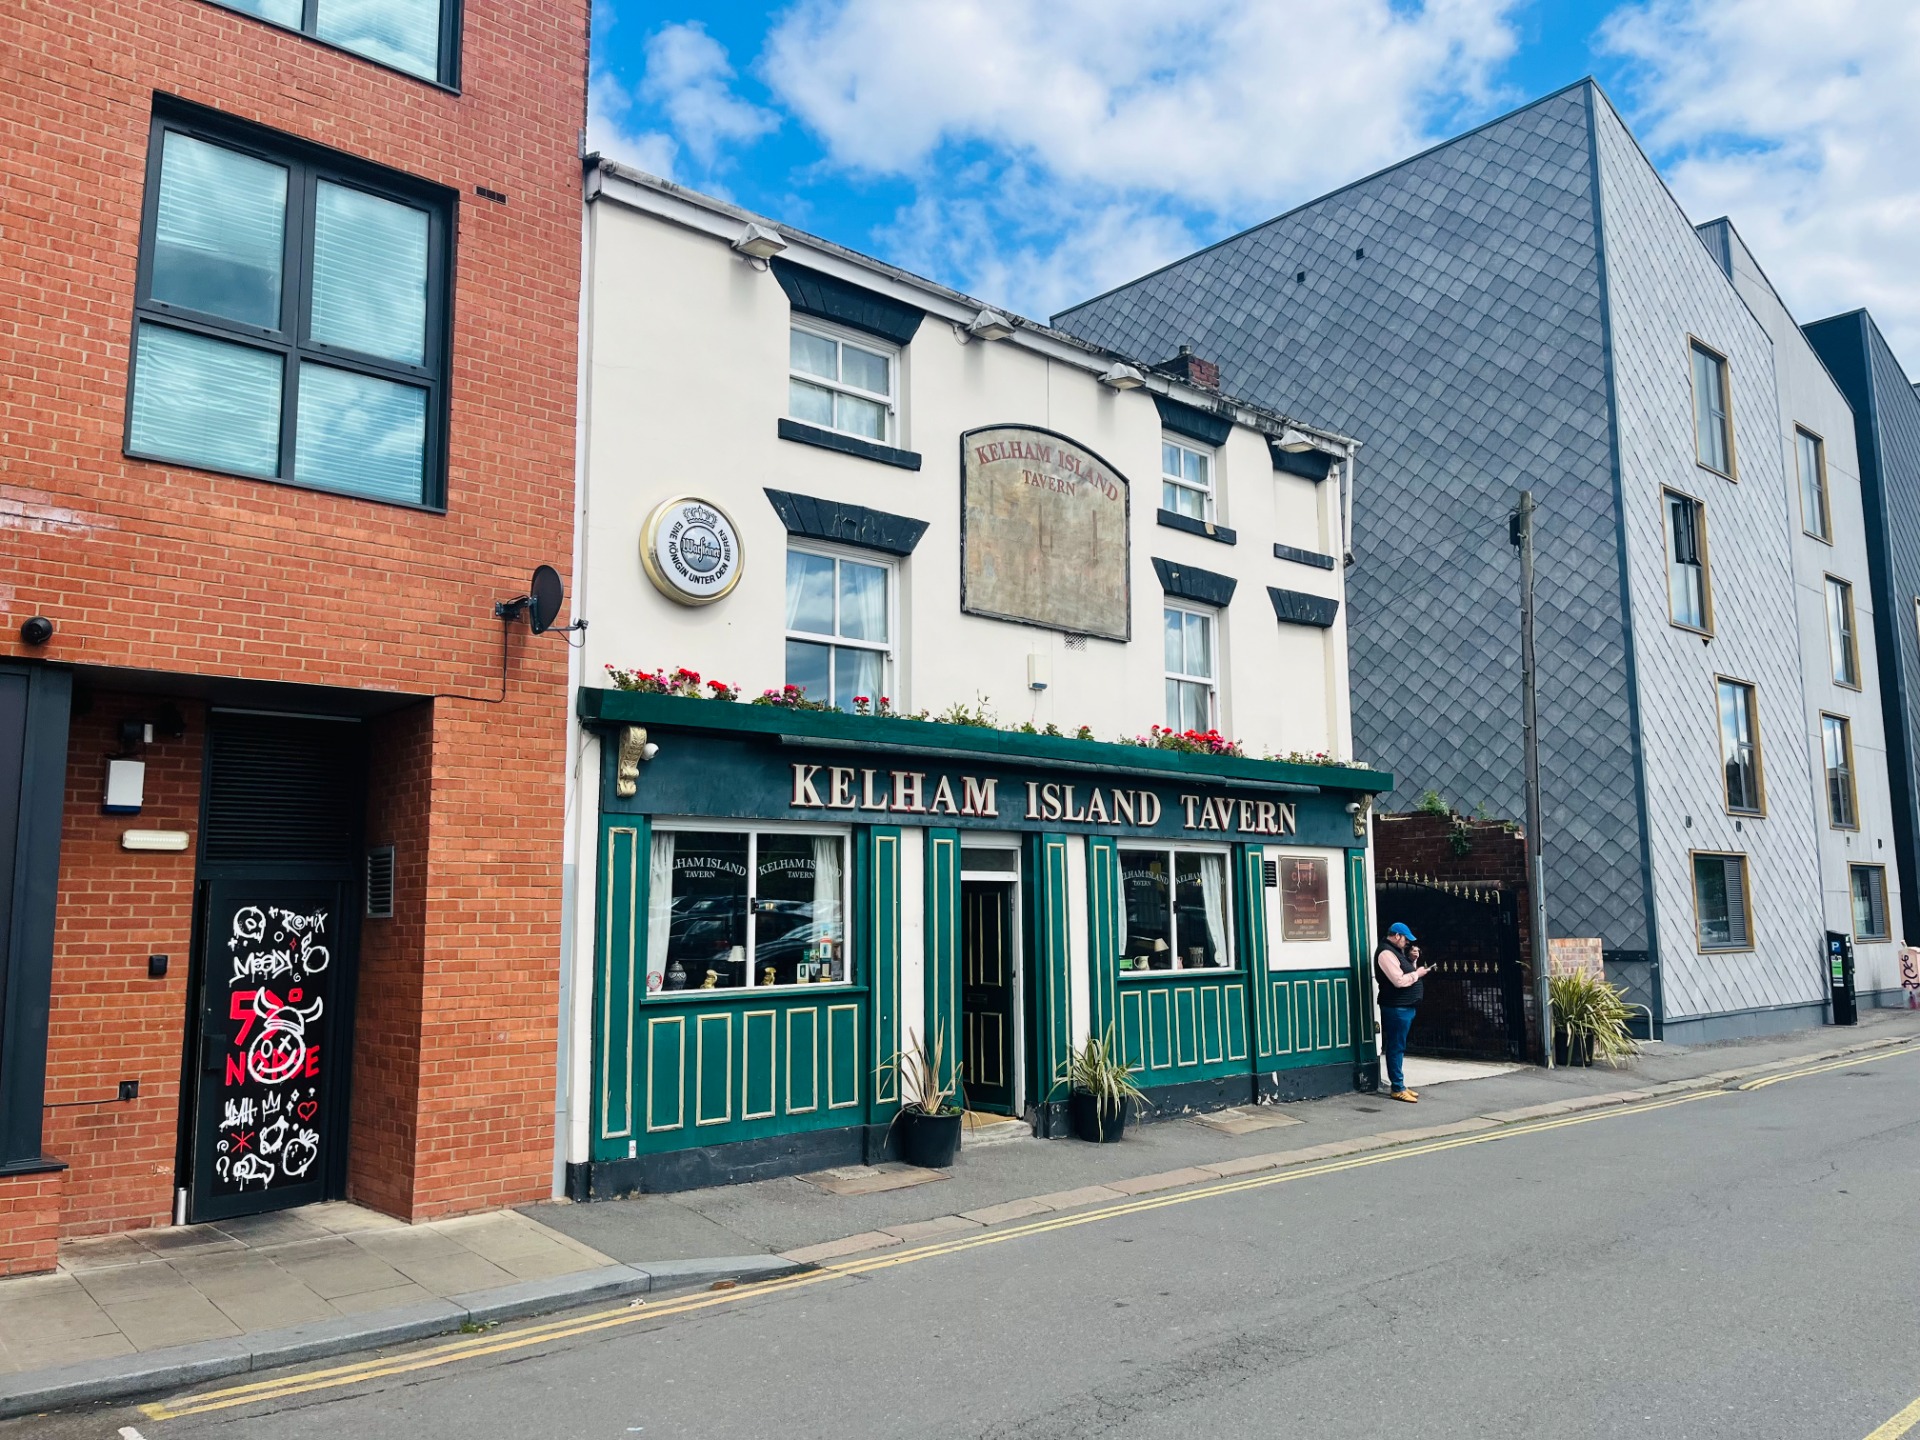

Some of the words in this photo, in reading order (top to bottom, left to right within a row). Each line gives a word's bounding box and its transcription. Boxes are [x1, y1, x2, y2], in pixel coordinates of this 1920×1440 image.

[975, 441, 1052, 465] KELHAM
[1057, 450, 1118, 501] ISLAND
[1022, 469, 1076, 496] TAVERN
[669, 521, 684, 540] EINE
[717, 529, 731, 562] BIEREN
[669, 541, 689, 578] KÖNIGIN
[688, 573, 716, 585] UNTER
[715, 562, 729, 580] DEN
[790, 763, 999, 818] KELHAM
[1025, 781, 1162, 827] ISLAND
[1180, 794, 1297, 835] TAVERN
[684, 870, 716, 878] TAVERN
[706, 857, 747, 877] ISLAND
[758, 858, 805, 876] KELHAM
[787, 870, 815, 879] TAVERN
[1144, 870, 1169, 885] ISLAND
[1831, 941, 1840, 951] P
